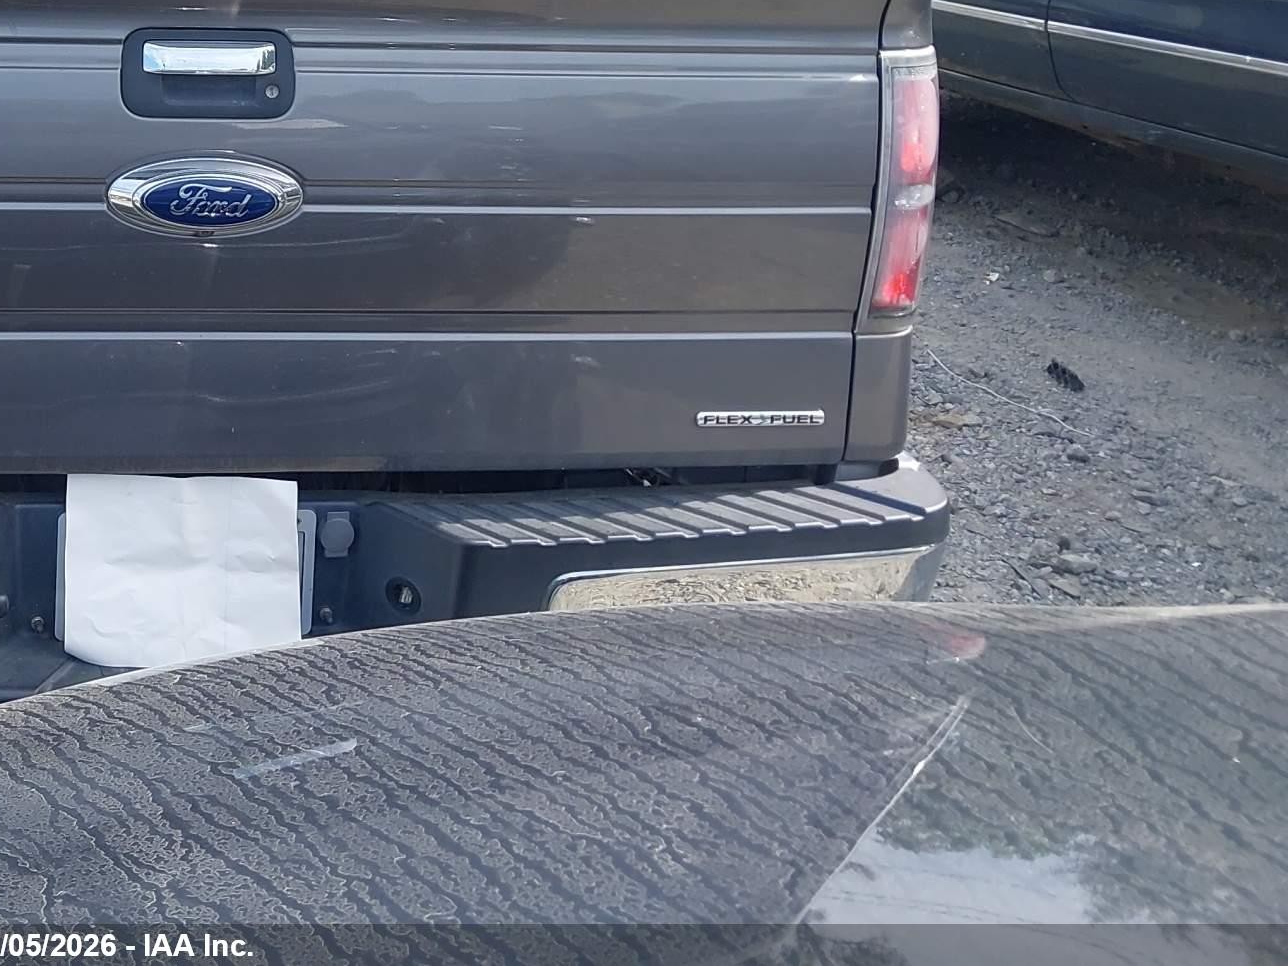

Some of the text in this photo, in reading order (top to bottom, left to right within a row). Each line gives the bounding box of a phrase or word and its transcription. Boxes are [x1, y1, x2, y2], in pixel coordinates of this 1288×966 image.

[170, 183, 252, 218] Ford
[703, 414, 820, 425] FLEX FUEL
